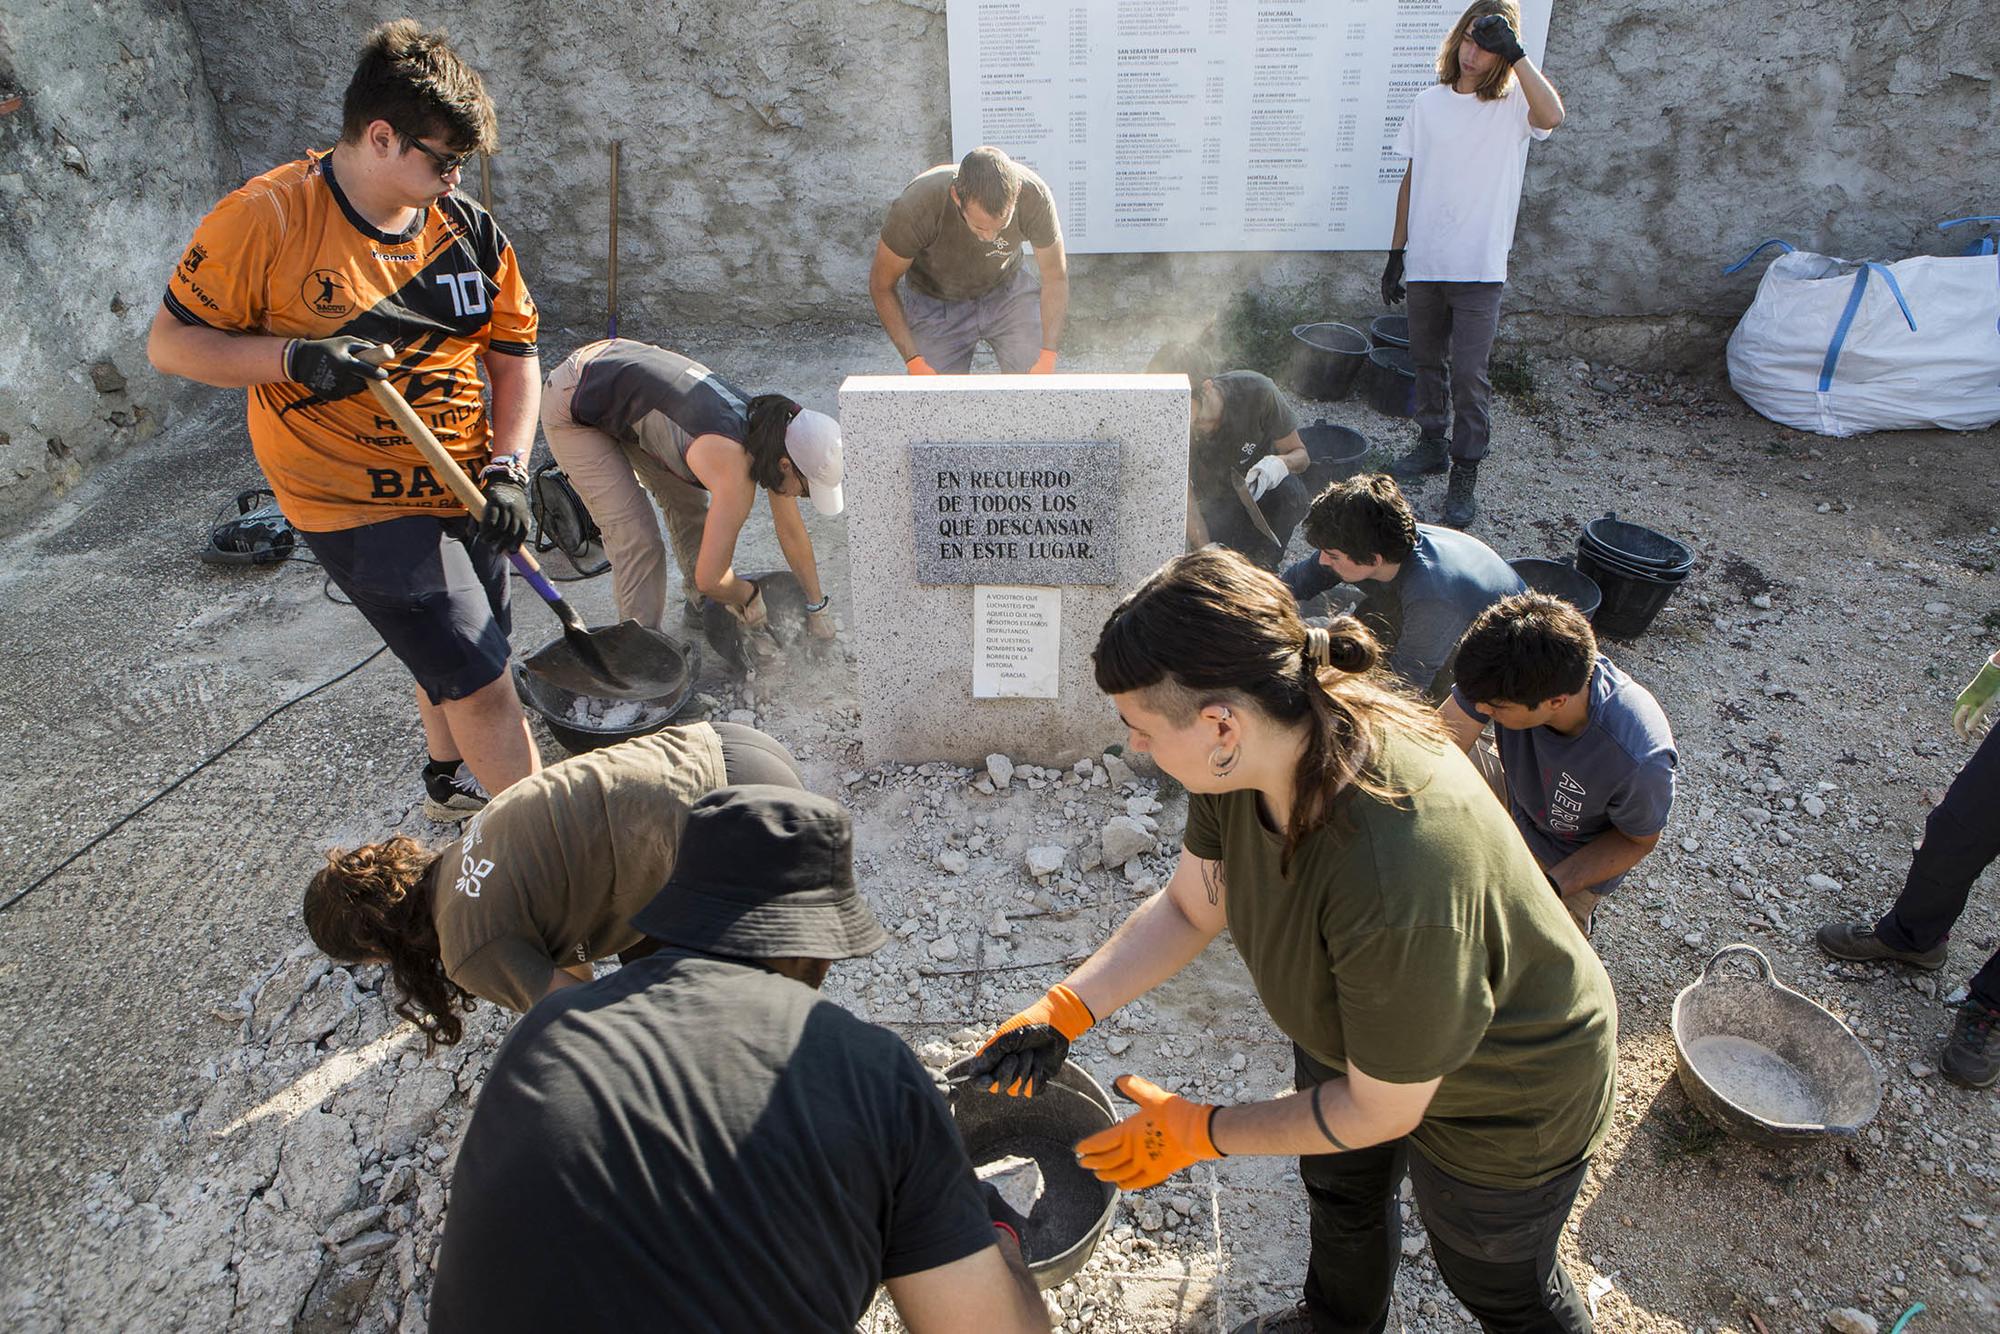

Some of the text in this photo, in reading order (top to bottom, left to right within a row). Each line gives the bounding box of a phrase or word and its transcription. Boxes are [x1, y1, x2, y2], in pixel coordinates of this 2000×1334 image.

[191, 283, 220, 311] Viejo
[937, 470, 1071, 488] EN RECUERDO
[938, 495, 1076, 512] DE TODOS LOS
[939, 518, 1093, 538] QUE DESCANSAN
[941, 543, 1093, 559] EN ESTE LUGAR.
[1551, 772, 1586, 831] AERO
